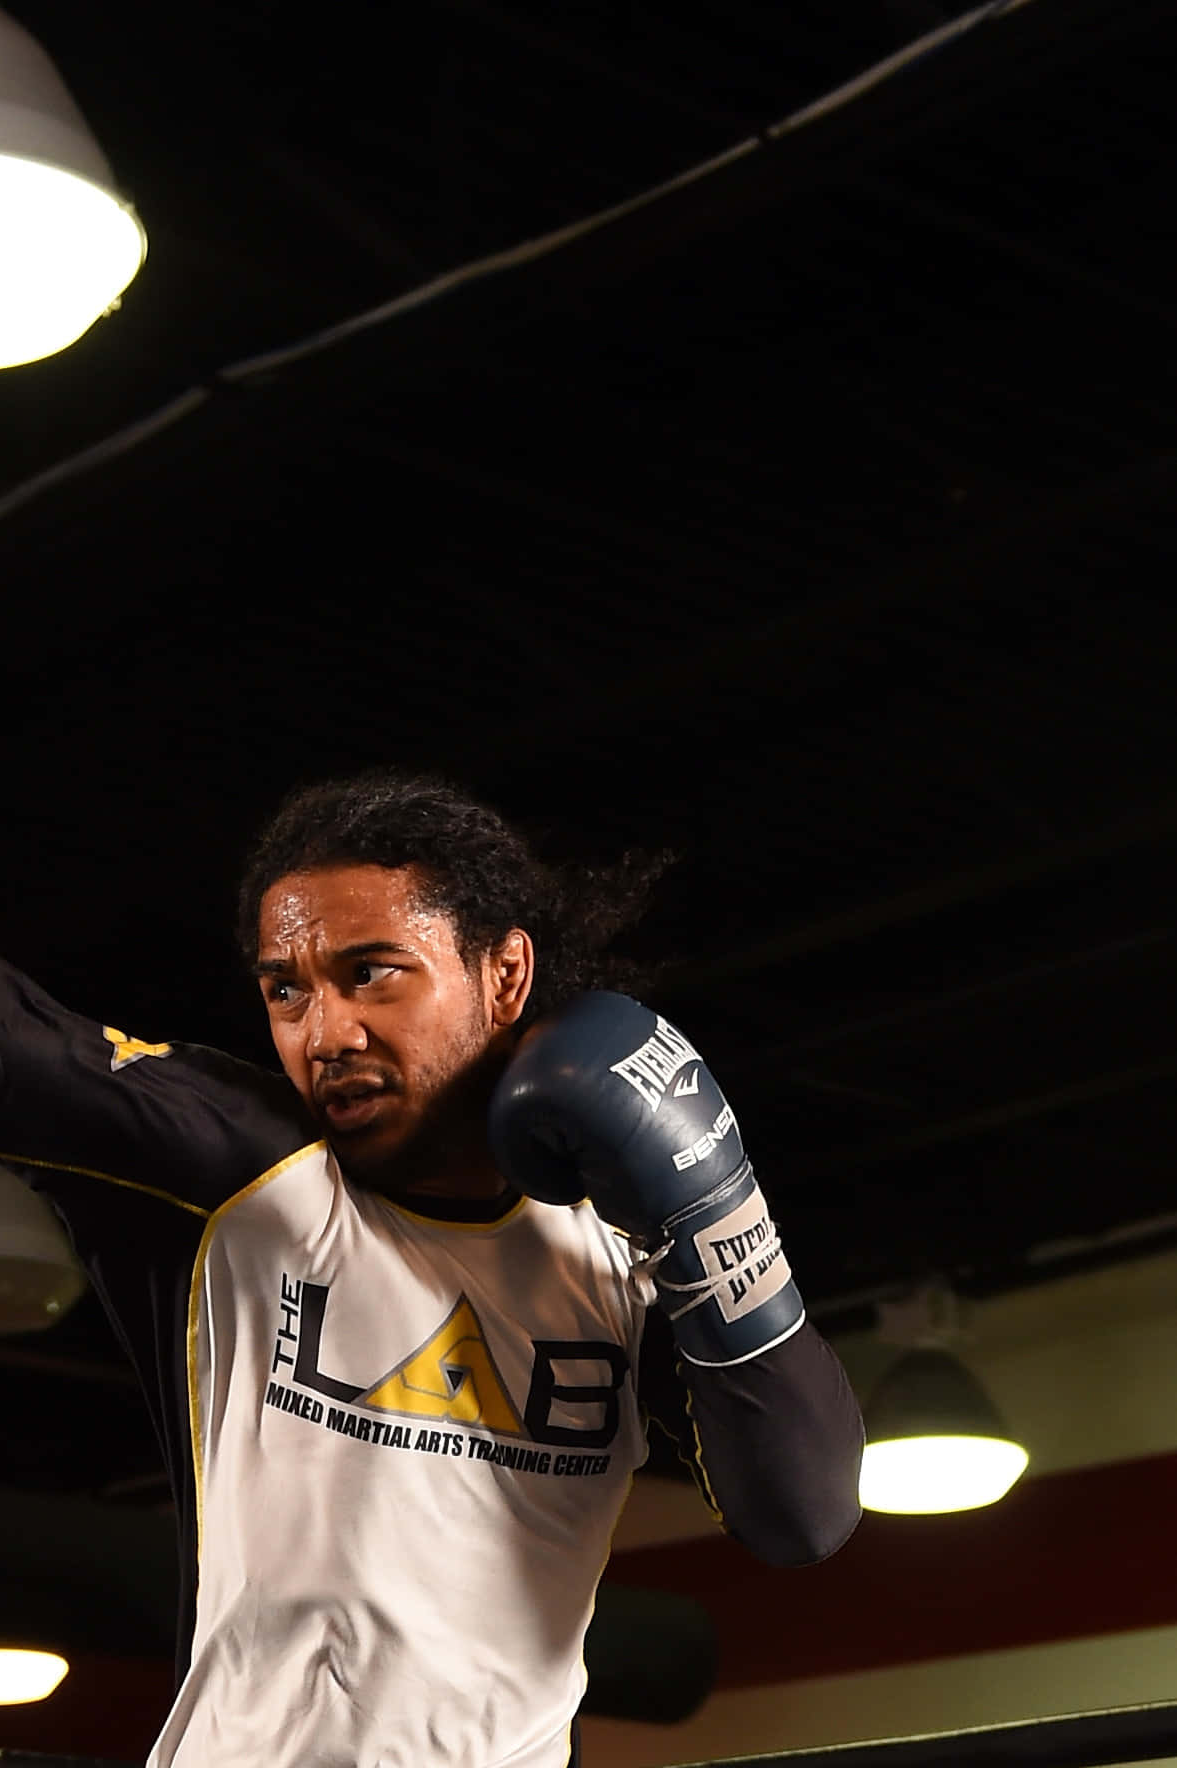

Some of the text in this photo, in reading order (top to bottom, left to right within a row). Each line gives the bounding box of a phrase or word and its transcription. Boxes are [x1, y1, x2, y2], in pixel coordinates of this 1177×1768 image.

[272, 1272, 301, 1373] THE
[293, 1277, 629, 1449] LAB
[265, 1382, 611, 1476] MIXED MARTIAL ARTS TRAINING CENTER
